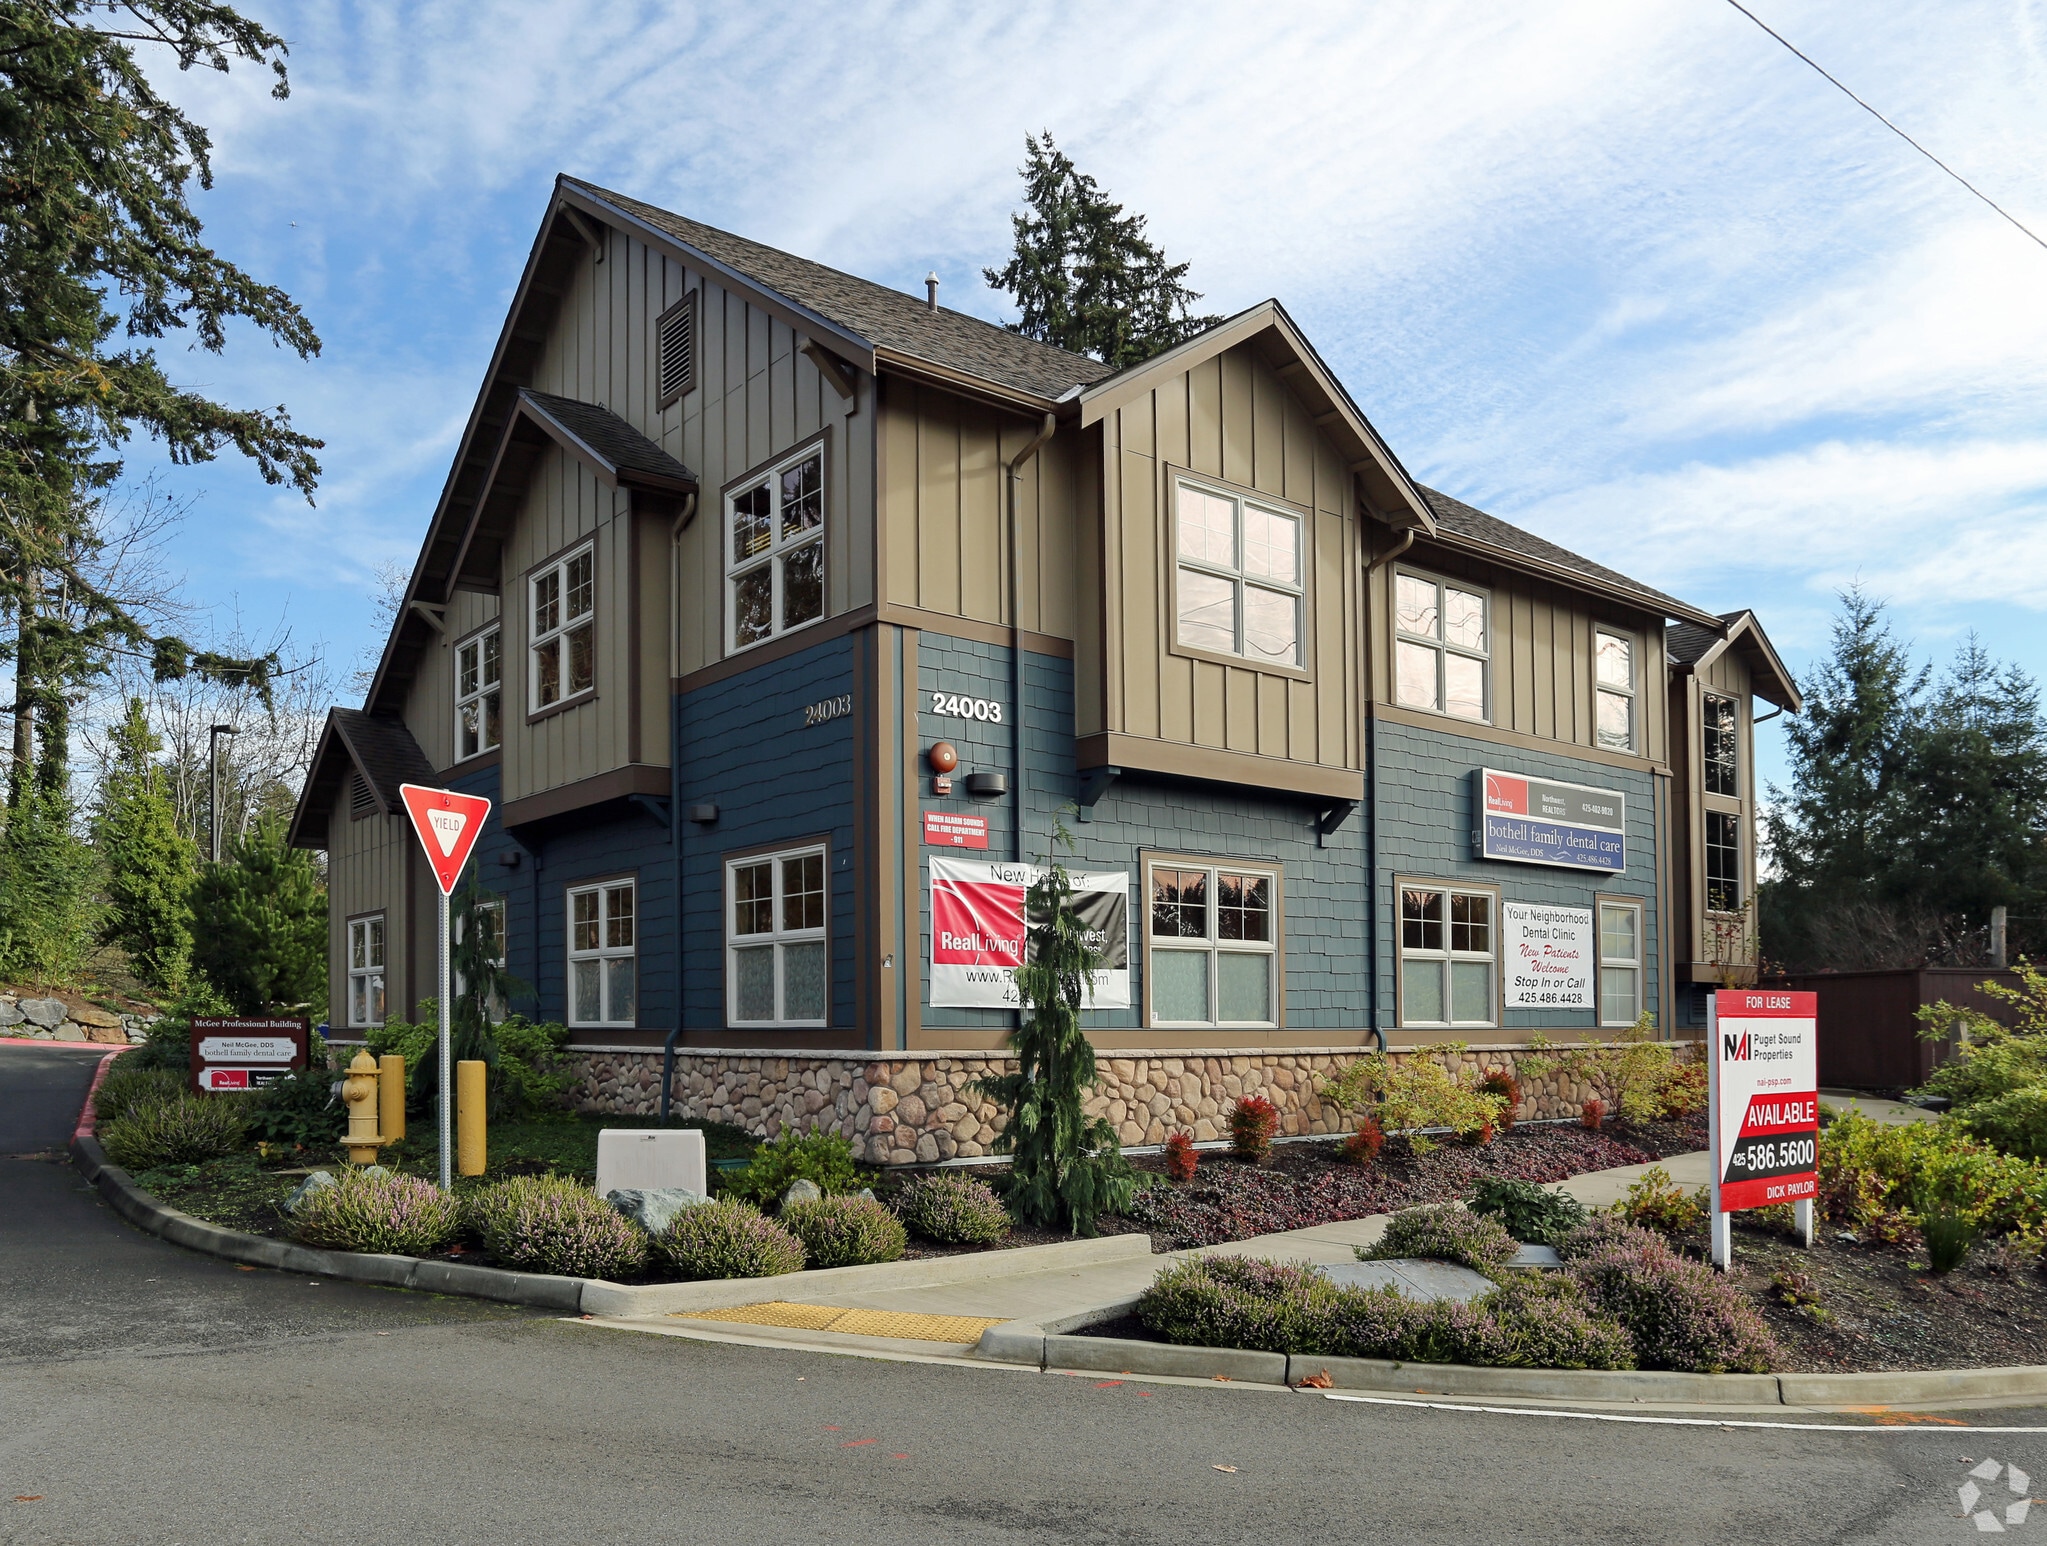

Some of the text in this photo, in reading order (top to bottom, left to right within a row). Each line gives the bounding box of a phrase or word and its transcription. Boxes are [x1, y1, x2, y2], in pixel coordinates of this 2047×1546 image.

[805, 694, 851, 726] 24003
[932, 692, 1002, 723] 24003
[1542, 805, 1566, 816] REALTORS
[434, 816, 460, 831] YIELD
[928, 814, 984, 827] WHEN ALARM SOUNDS
[927, 824, 985, 836] CALL FIRE DEPARTMENT
[1489, 820, 1620, 853] bothell family dental care
[1496, 844, 1544, 857] Neil McGee, DDS
[1577, 854, 1611, 865] 425.486.4428
[990, 864, 1026, 882] New
[1507, 907, 1589, 925] Your Neighborhood
[1522, 926, 1576, 941] Dental Clinic
[1519, 943, 1580, 959] New Patients
[1531, 960, 1569, 973] Welcome
[1515, 976, 1586, 989] Stop In or Call
[1519, 992, 1583, 1003] 425.486.4428
[1746, 996, 1791, 1009] FOR LEASE
[222, 1020, 268, 1028] Professional
[270, 1021, 302, 1030] Building
[1724, 1027, 1751, 1061] NAI
[1754, 1033, 1801, 1047] Puget Sound
[230, 1049, 252, 1058] family
[1754, 1049, 1793, 1062] Properties
[1757, 1077, 1792, 1088] nai-psp.com
[1747, 1101, 1815, 1127] AVAILABLE
[1732, 1139, 1814, 1171] 425 586.5600
[1767, 1180, 1815, 1199] DICK PAYLOR
